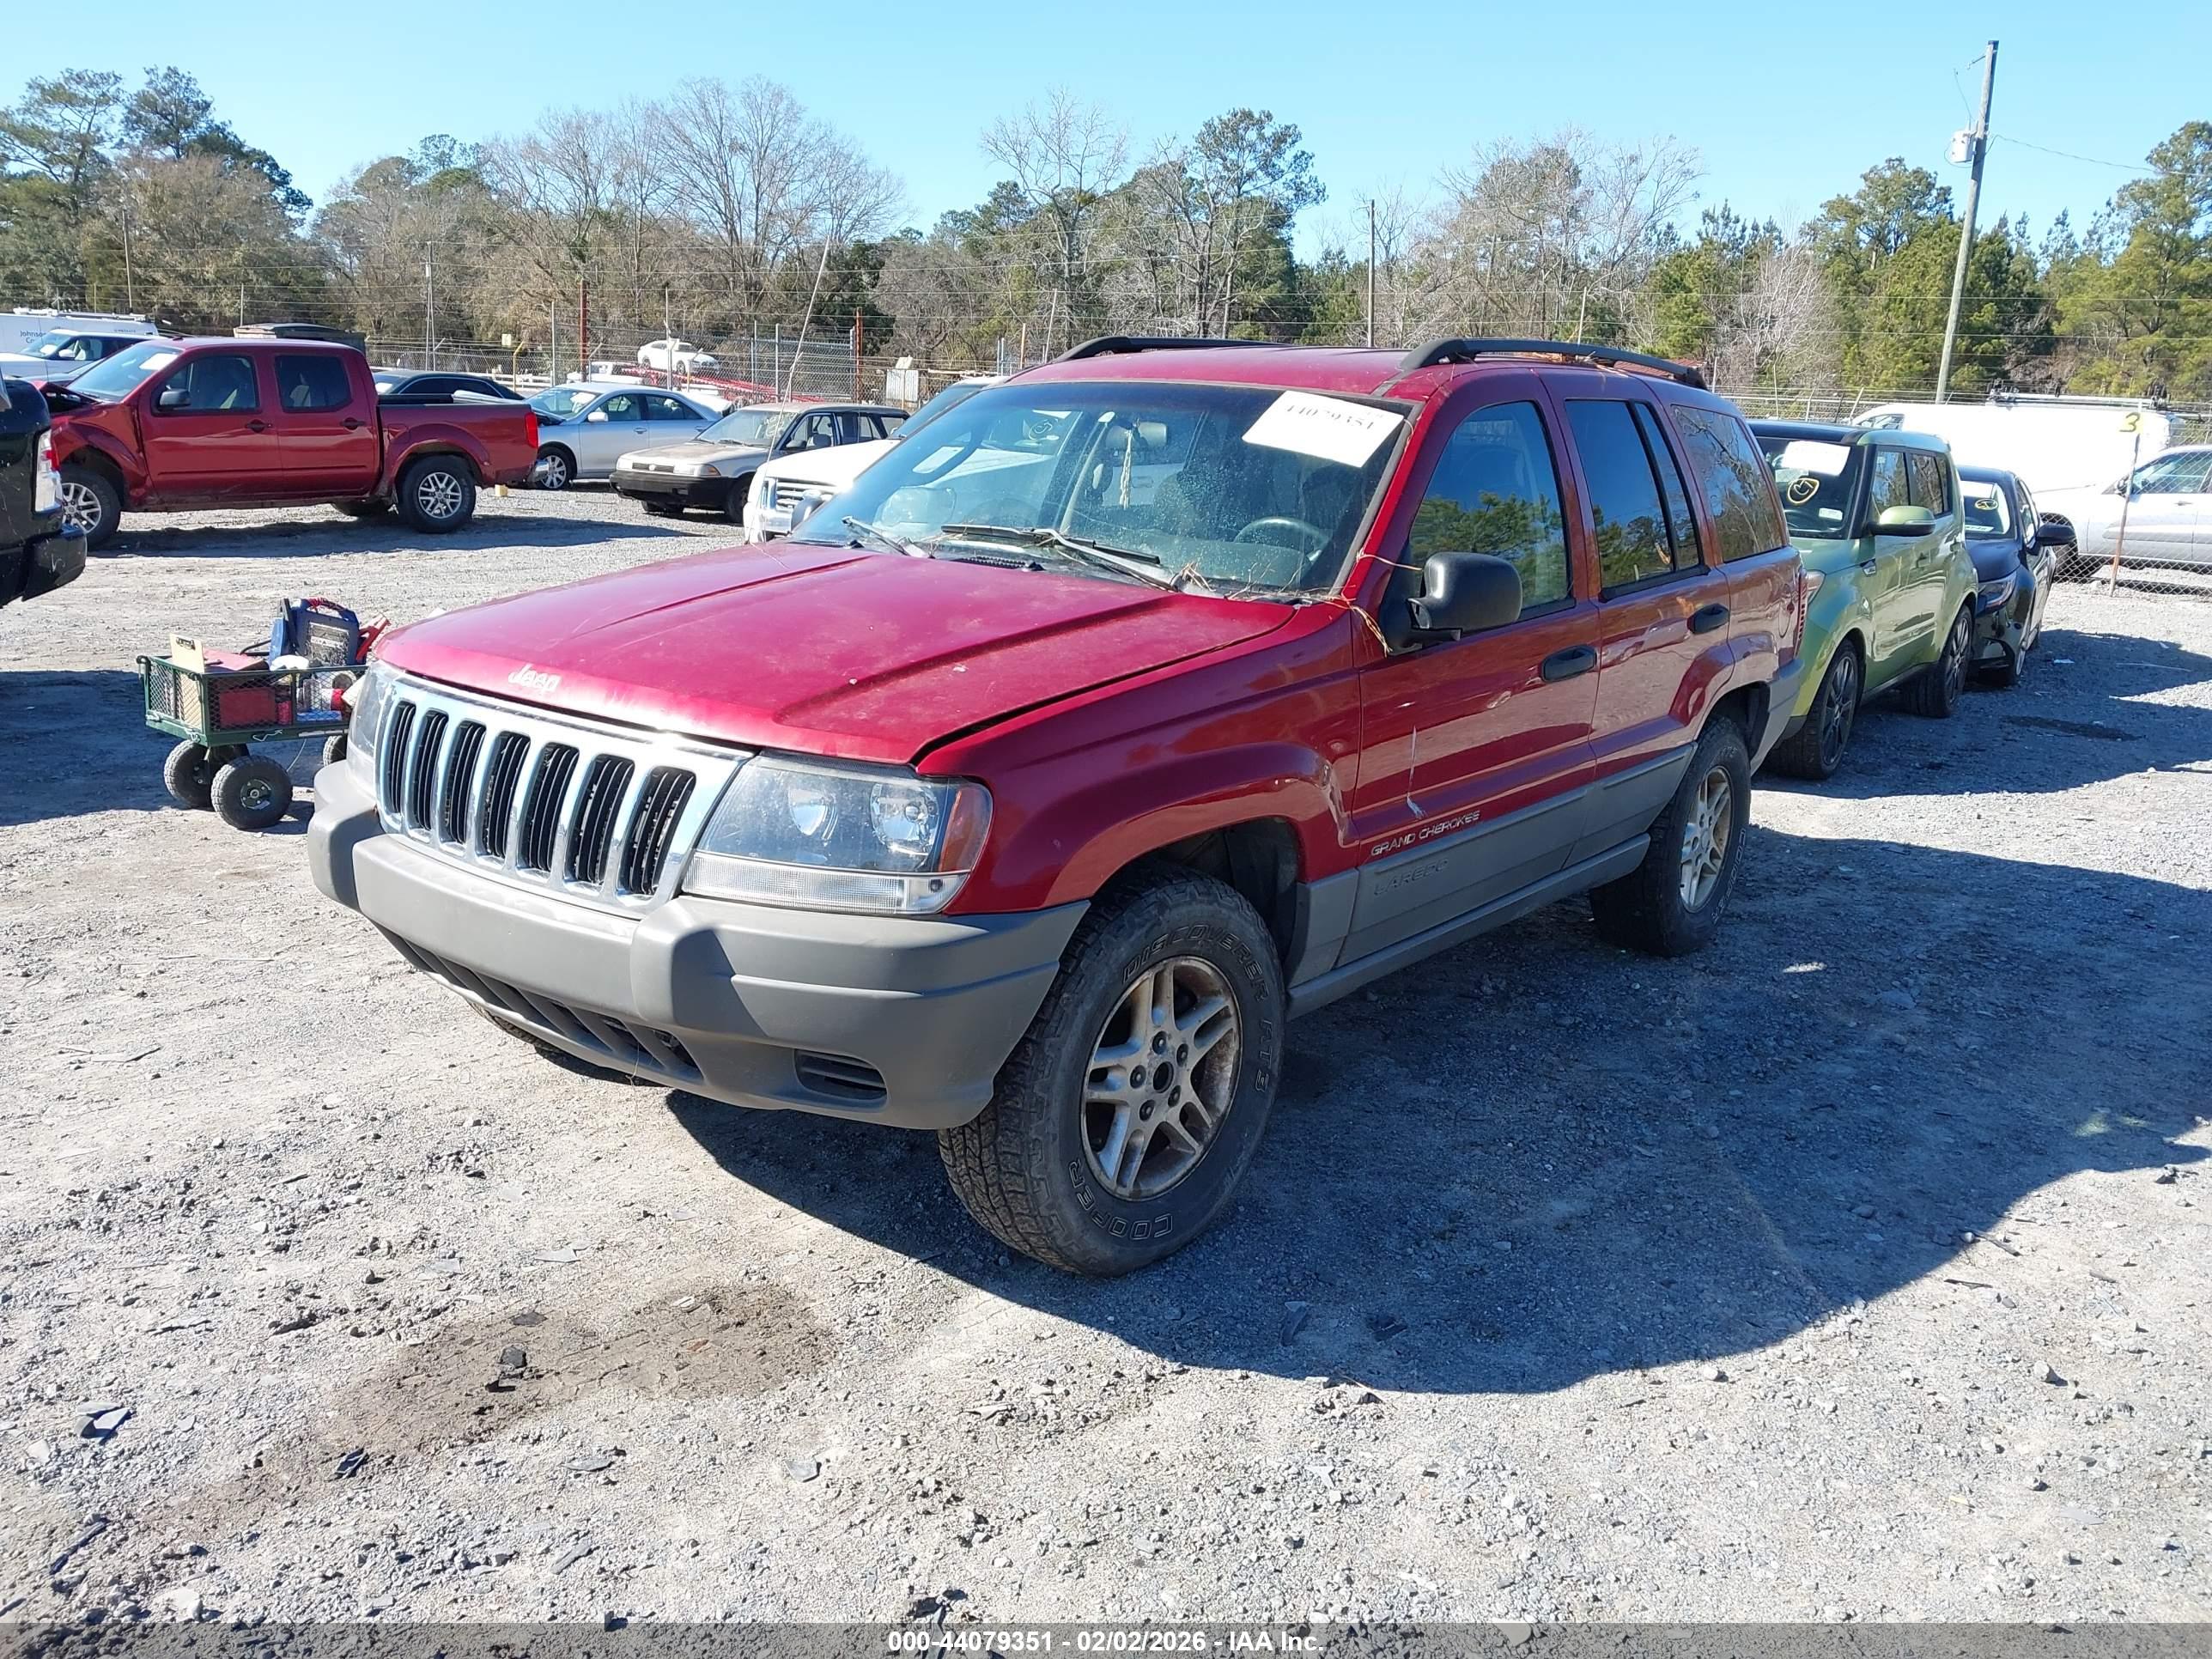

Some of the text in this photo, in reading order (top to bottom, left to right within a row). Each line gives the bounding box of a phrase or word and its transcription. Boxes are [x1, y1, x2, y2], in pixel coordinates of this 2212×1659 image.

[2119, 412, 2141, 433] 3
[507, 662, 563, 696] Jeep
[1370, 810, 1480, 856] GRAND CHEROKEE
[1374, 859, 1449, 896] LAREDO
[1121, 924, 1269, 1003] DISCOVERER
[1068, 1158, 1173, 1241] COOPER
